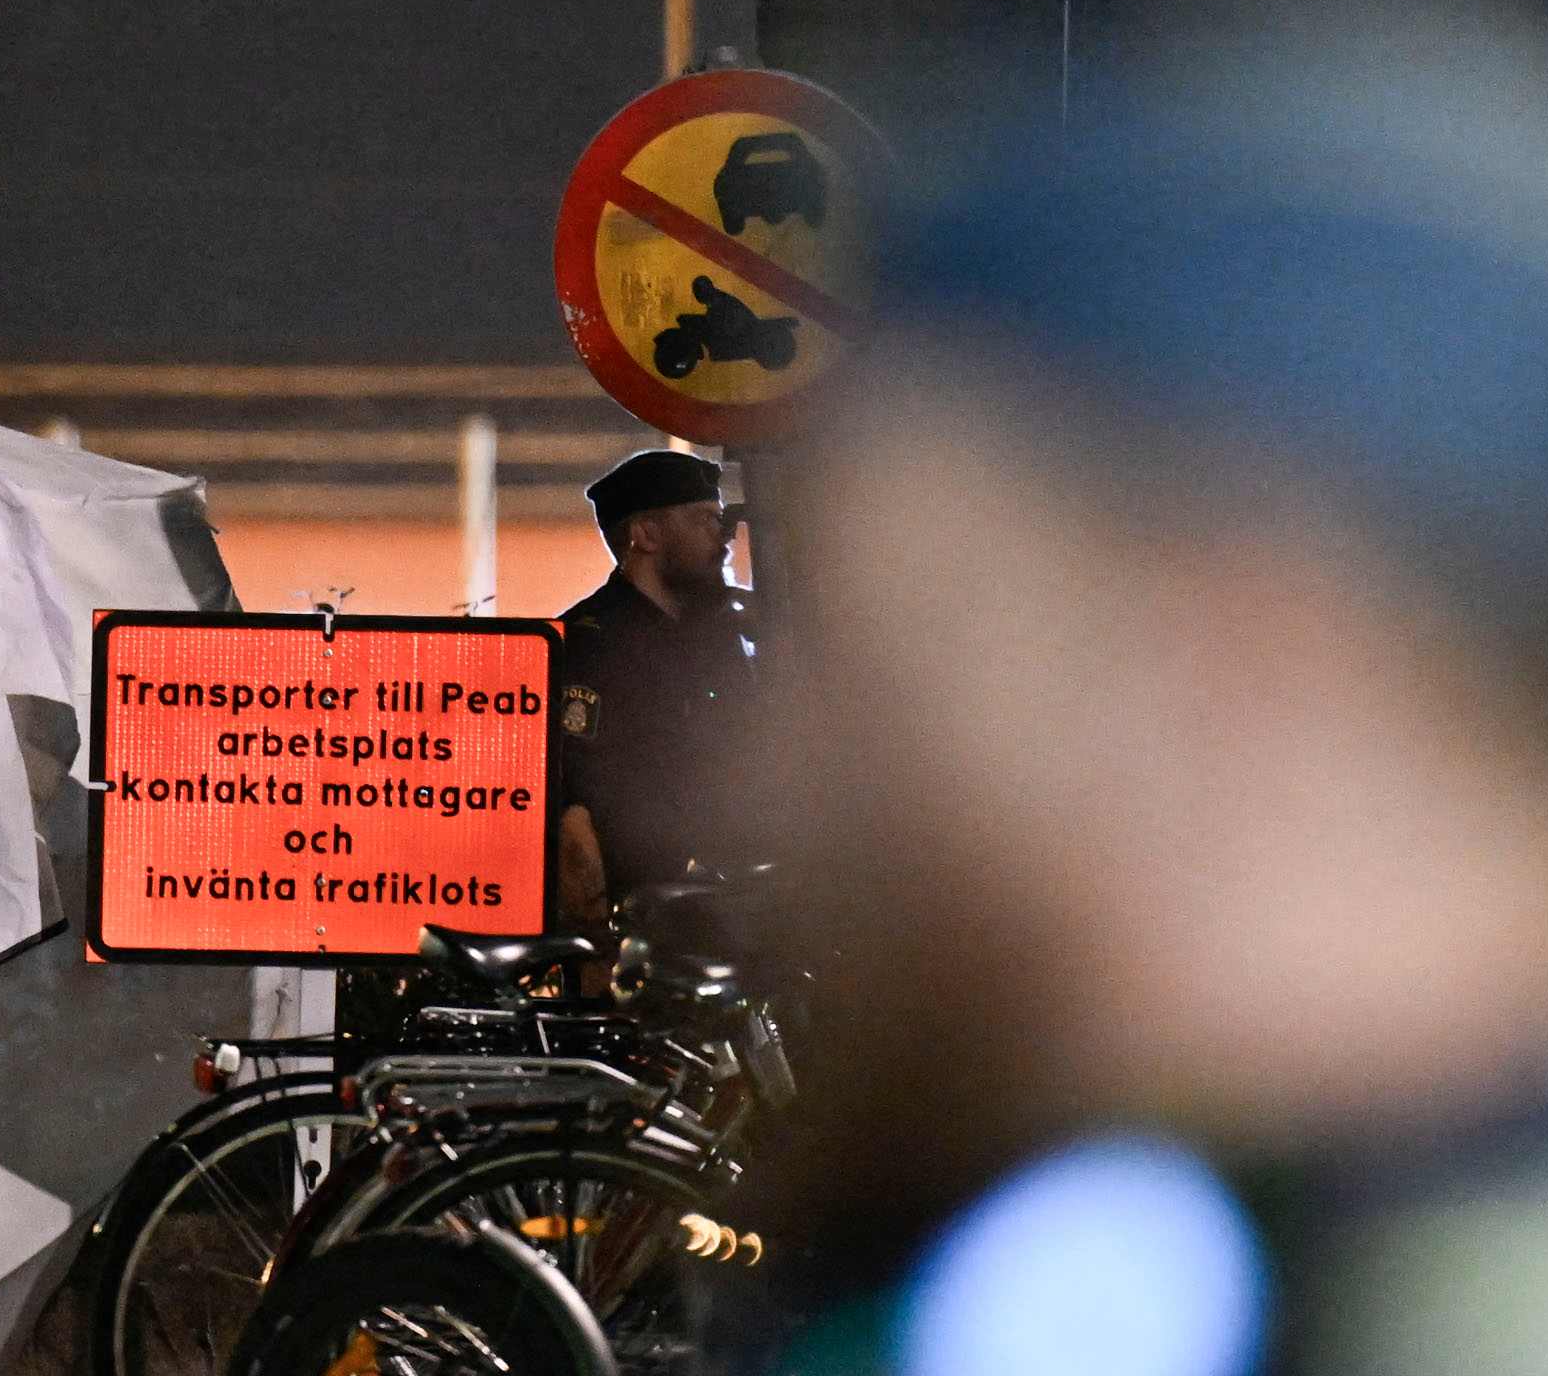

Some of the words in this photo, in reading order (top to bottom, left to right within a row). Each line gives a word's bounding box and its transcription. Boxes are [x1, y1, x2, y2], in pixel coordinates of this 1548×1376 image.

[118, 674, 359, 715] Transporter
[377, 681, 423, 712] till
[441, 682, 541, 715] Peab
[218, 727, 453, 766] arbetsplats
[121, 771, 303, 806] kontakta
[321, 778, 532, 817] mottagare
[284, 823, 353, 854] och
[146, 866, 296, 901] invänta
[313, 872, 503, 906] trafiklots
